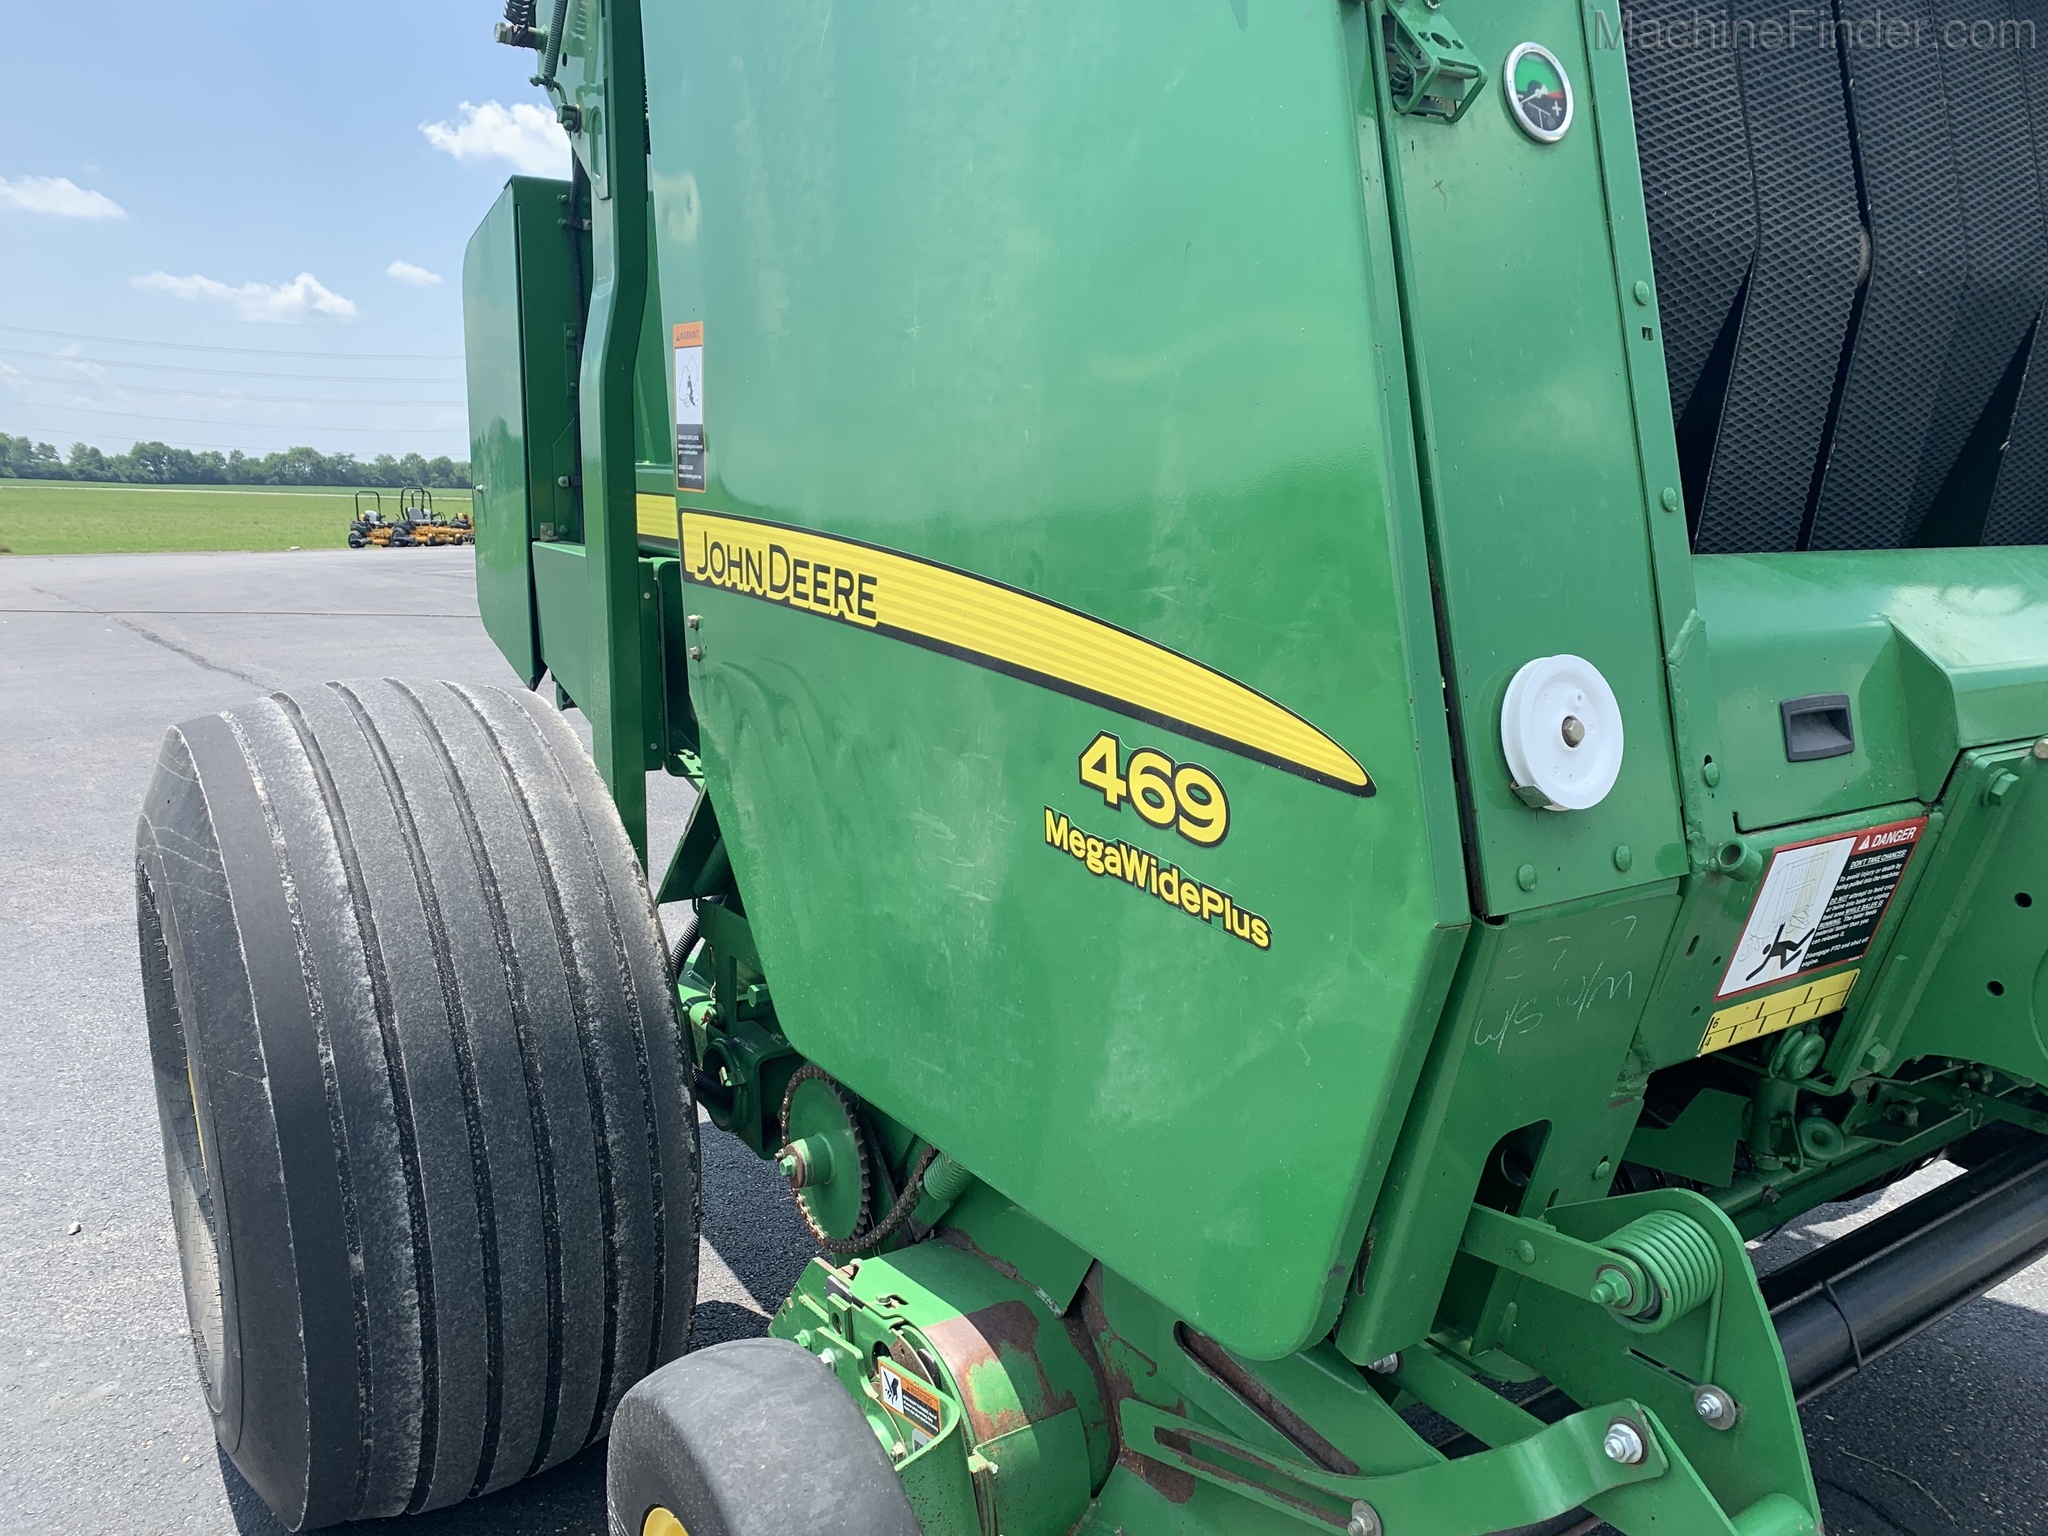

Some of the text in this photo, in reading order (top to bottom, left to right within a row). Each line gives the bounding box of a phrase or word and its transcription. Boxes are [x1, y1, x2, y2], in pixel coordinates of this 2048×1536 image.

[679, 330, 699, 341] WARNING
[1079, 731, 1230, 847] 469
[1871, 827, 1917, 848] DANGER
[1044, 807, 1271, 950] MegaWidePlus
[1713, 1018, 1720, 1028] 6
